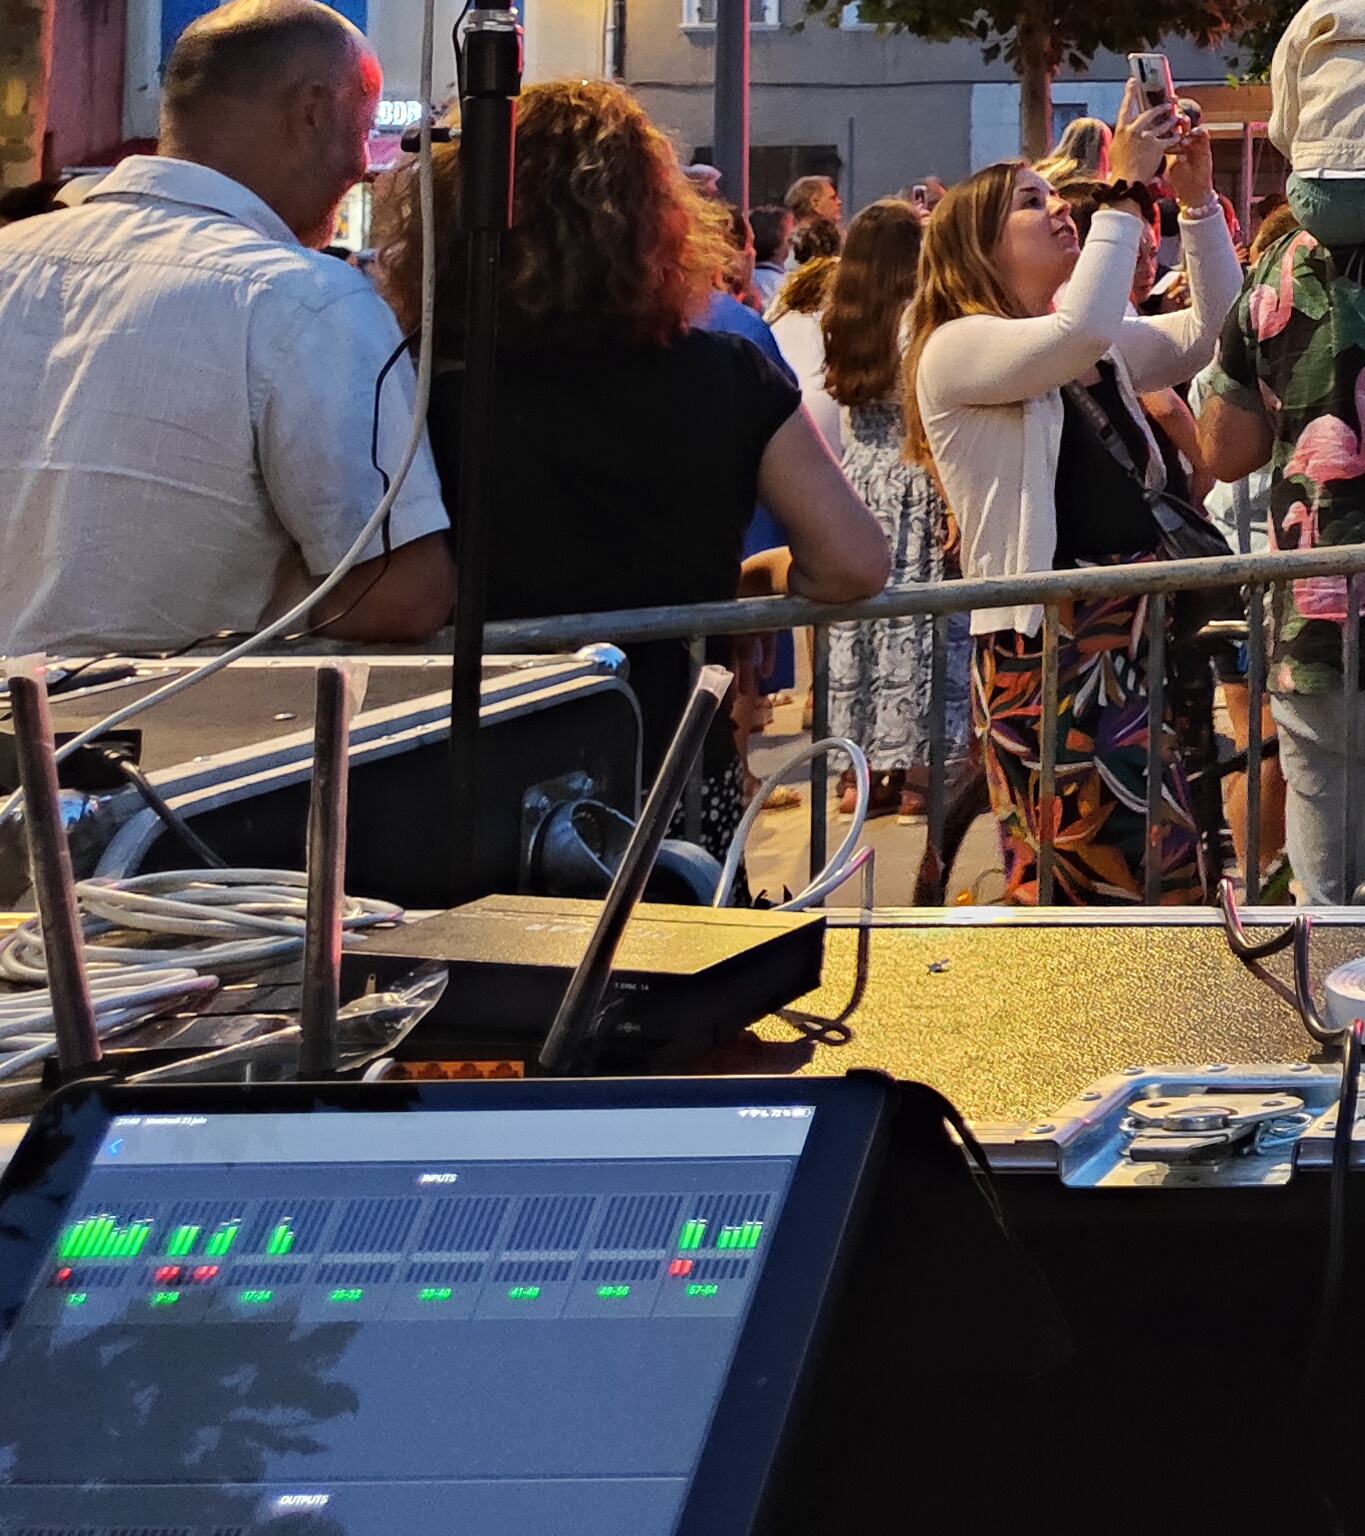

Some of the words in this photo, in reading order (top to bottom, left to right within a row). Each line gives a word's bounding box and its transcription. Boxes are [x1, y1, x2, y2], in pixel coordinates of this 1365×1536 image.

[421, 1173, 458, 1183] INPUTS
[242, 1290, 272, 1302] 17-24
[688, 1284, 718, 1296] 57-64
[280, 1493, 330, 1505] OUTPUTS
